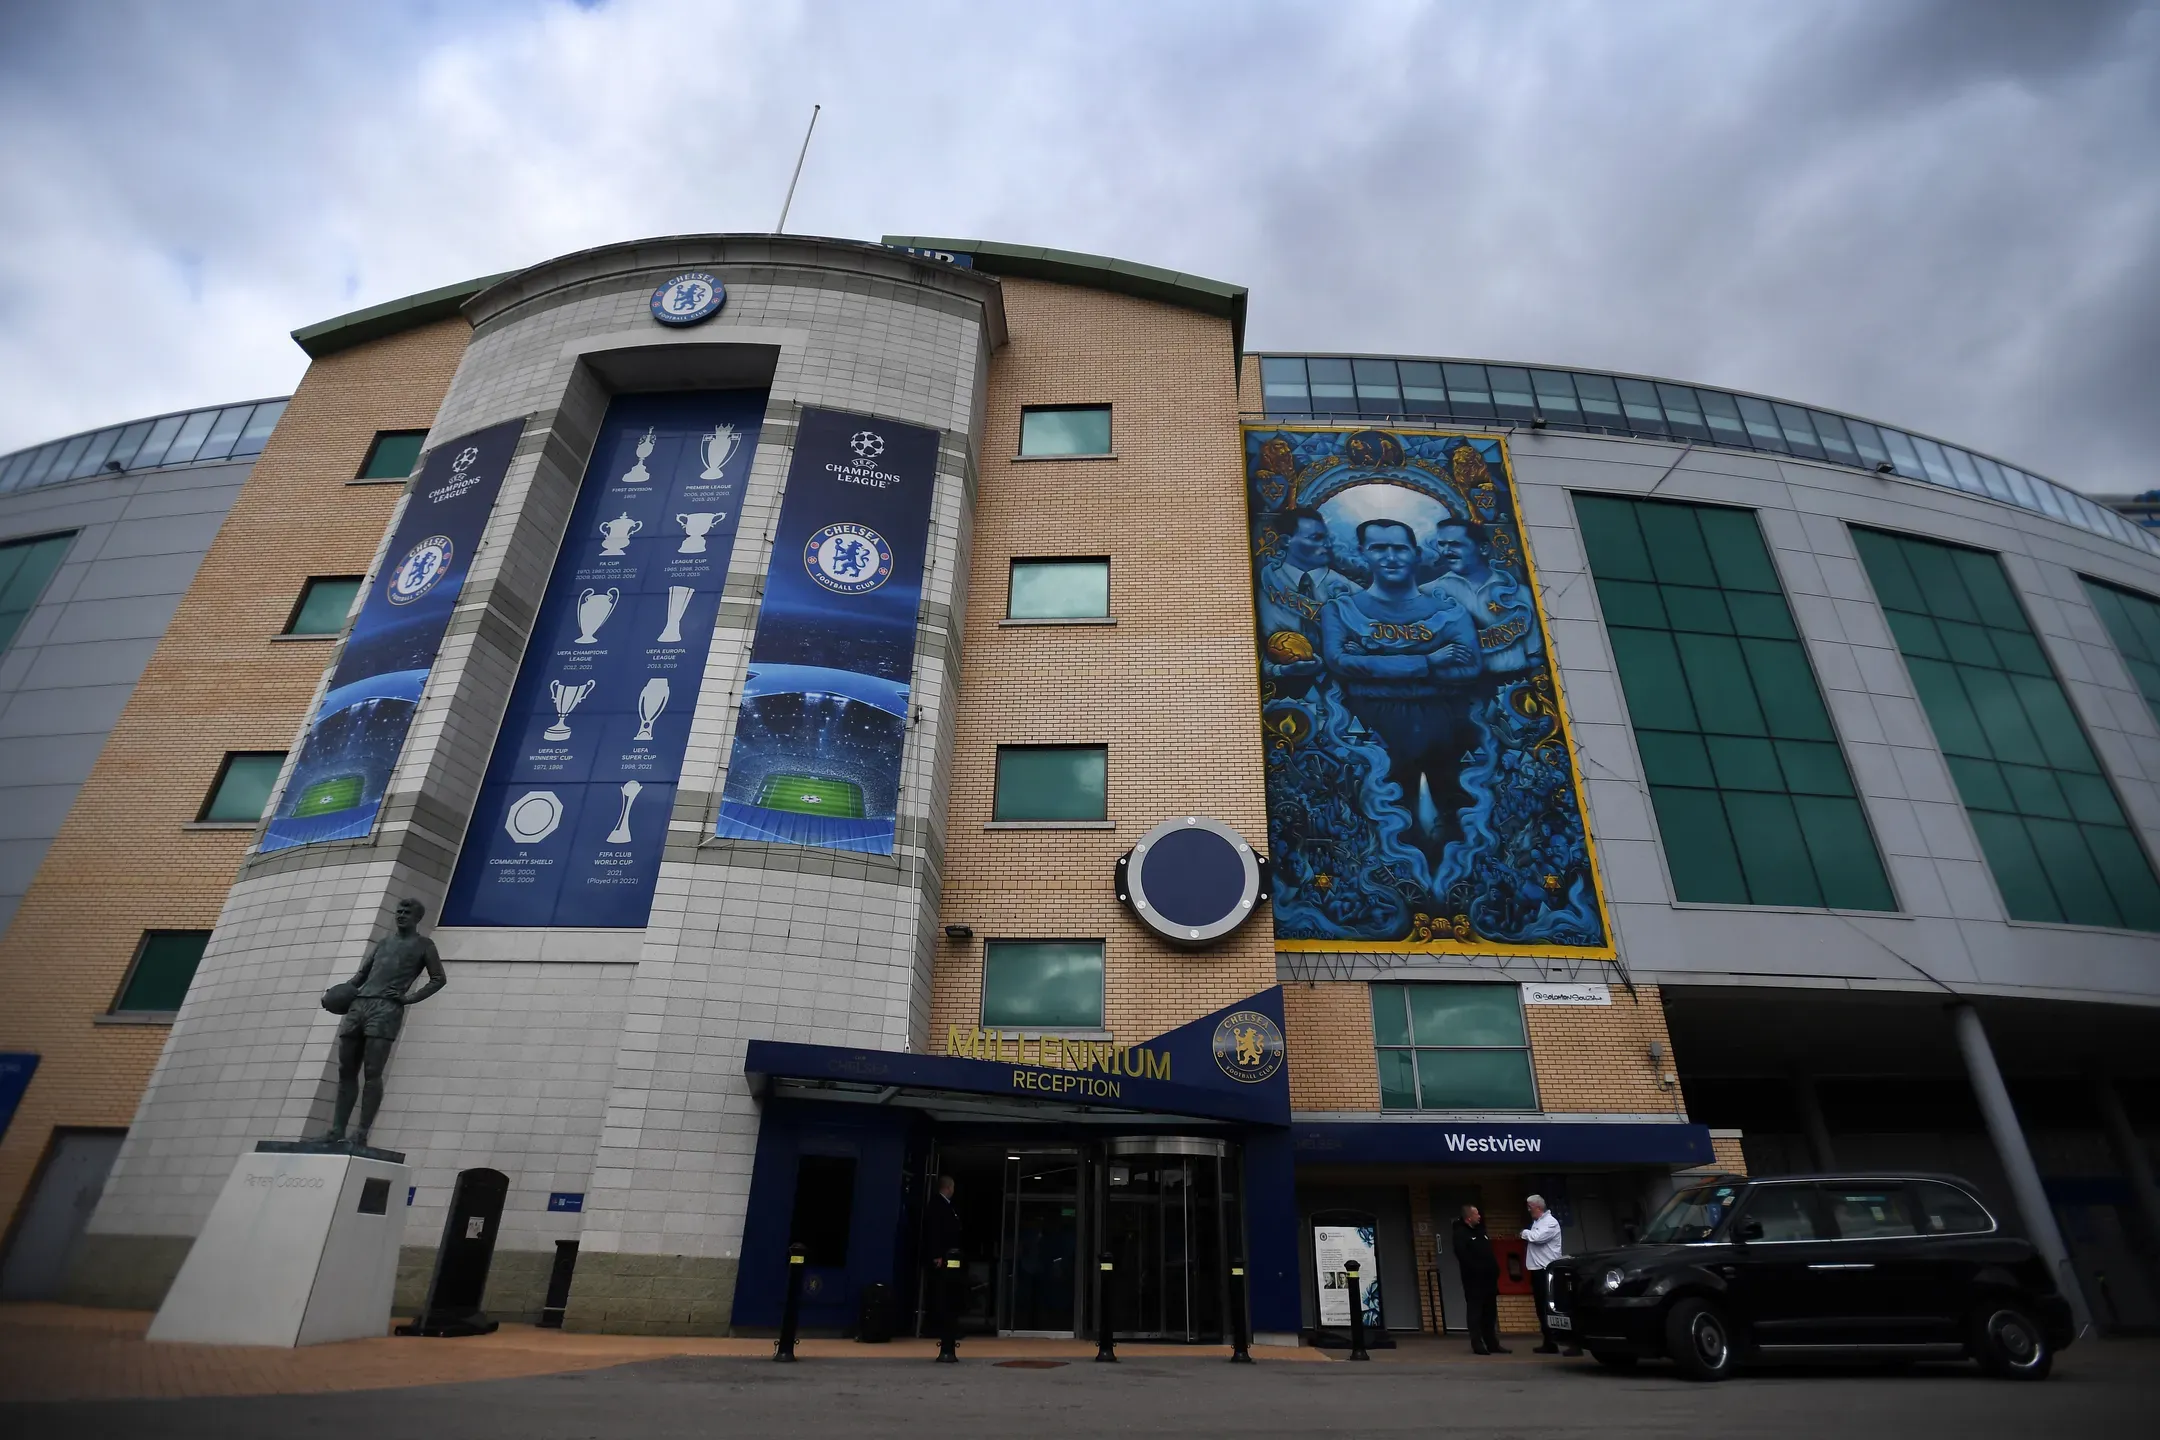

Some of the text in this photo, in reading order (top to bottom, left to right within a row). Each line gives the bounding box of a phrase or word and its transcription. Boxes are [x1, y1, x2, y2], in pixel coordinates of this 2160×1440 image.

[668, 273, 715, 285] CHELSEA
[658, 309, 708, 320] FOOTBALL CLUB
[825, 463, 900, 483] CHAMPIONS
[852, 459, 876, 470] UEFA
[428, 476, 481, 499] CHAMPIONS
[837, 473, 886, 489] LEAGUE
[433, 486, 468, 504] LEAGUE
[824, 525, 880, 545] CHELSEA
[409, 537, 448, 558] CHELSEA
[815, 572, 875, 591] FOOTBALL CLUB
[1269, 585, 1323, 621] WEISZ
[1369, 622, 1433, 641] JONES
[1478, 616, 1528, 649] HIRSCH
[587, 877, 611, 885] (Played
[619, 877, 639, 885] 2022)
[1553, 932, 1604, 946] SOUZA
[1224, 1013, 1269, 1029] CHELSEA
[946, 1024, 1172, 1081] MILLENNIUM
[1226, 1064, 1274, 1079] FOOTBALL CLUB
[1013, 1070, 1121, 1098] RECEPTION
[1444, 1133, 1541, 1152] Westview
[245, 1173, 274, 1188] PETER
